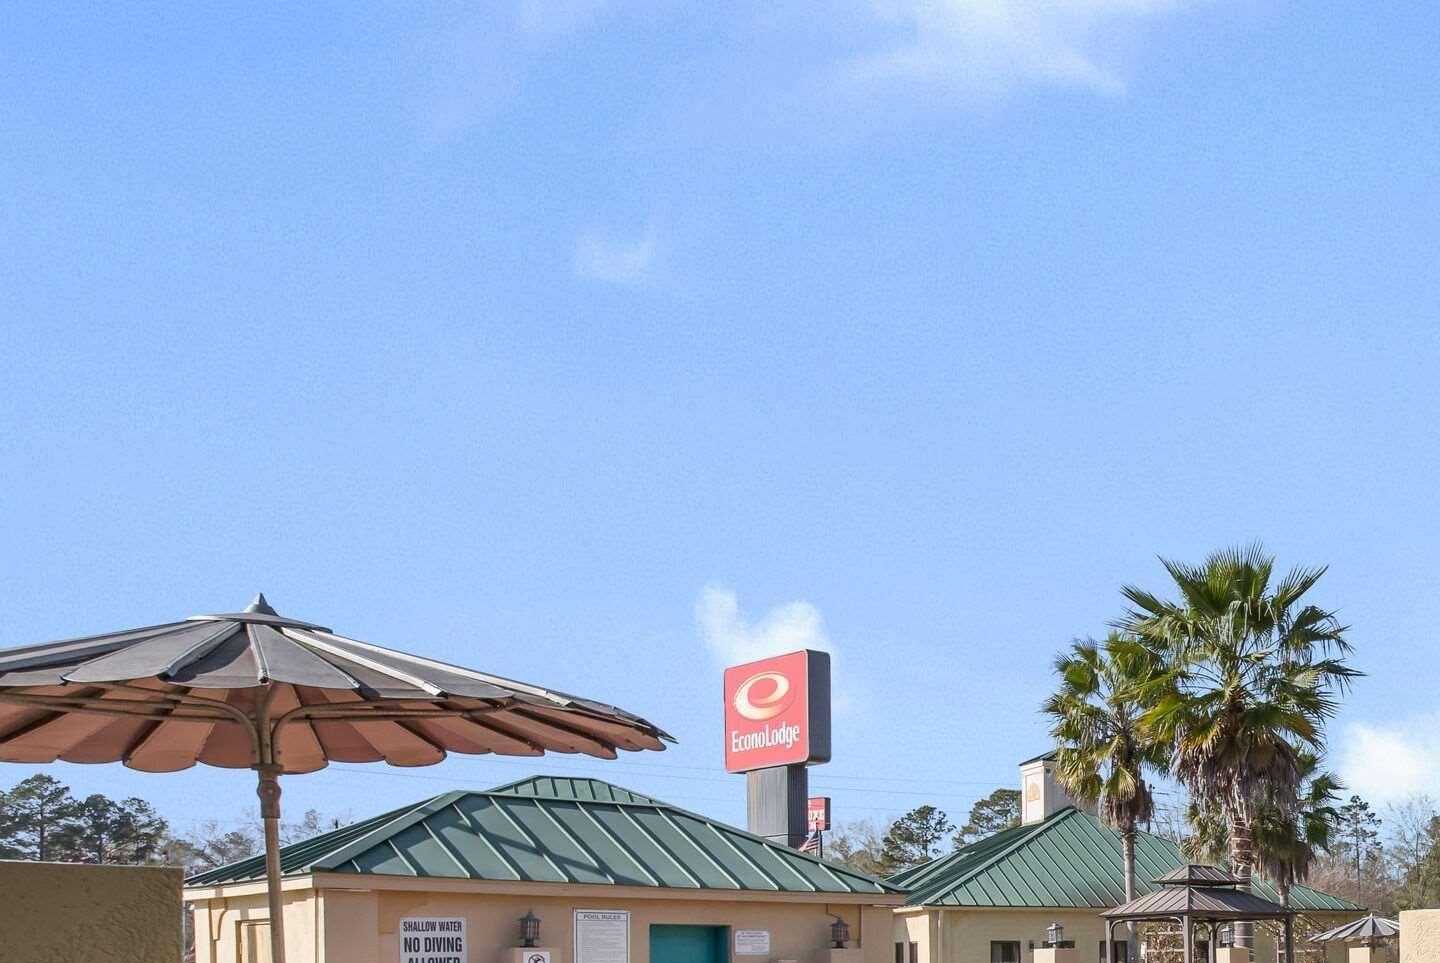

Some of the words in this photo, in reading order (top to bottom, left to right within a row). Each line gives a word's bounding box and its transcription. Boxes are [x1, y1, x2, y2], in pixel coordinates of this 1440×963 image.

[731, 720, 800, 752] EconoLodge
[403, 921, 437, 932] SHALLOW
[438, 921, 462, 932] WATER
[404, 937, 420, 952] NO
[424, 937, 463, 952] DIVING
